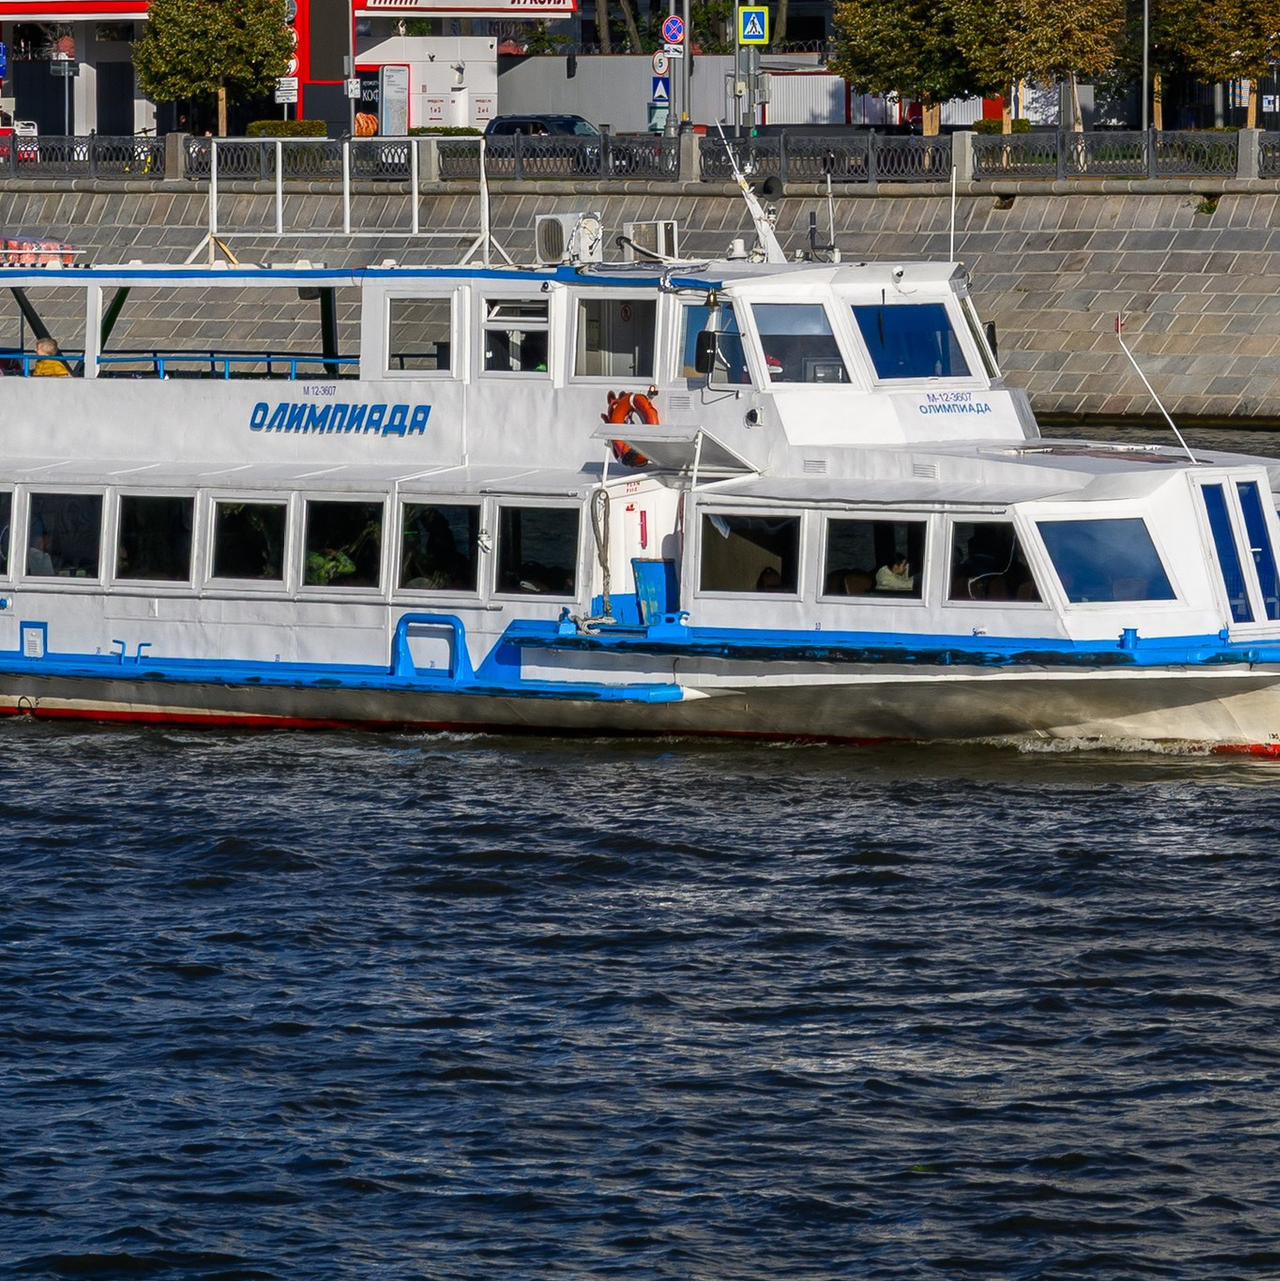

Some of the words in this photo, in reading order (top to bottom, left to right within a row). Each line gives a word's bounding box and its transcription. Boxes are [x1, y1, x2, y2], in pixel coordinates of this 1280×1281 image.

[658, 59, 663, 68] 5
[311, 386, 336, 396] 12-3607
[926, 392, 972, 403] М-12-3607
[919, 403, 992, 415] ОЛИМПИАДА
[250, 402, 432, 437] ОЛИМПИАДА
